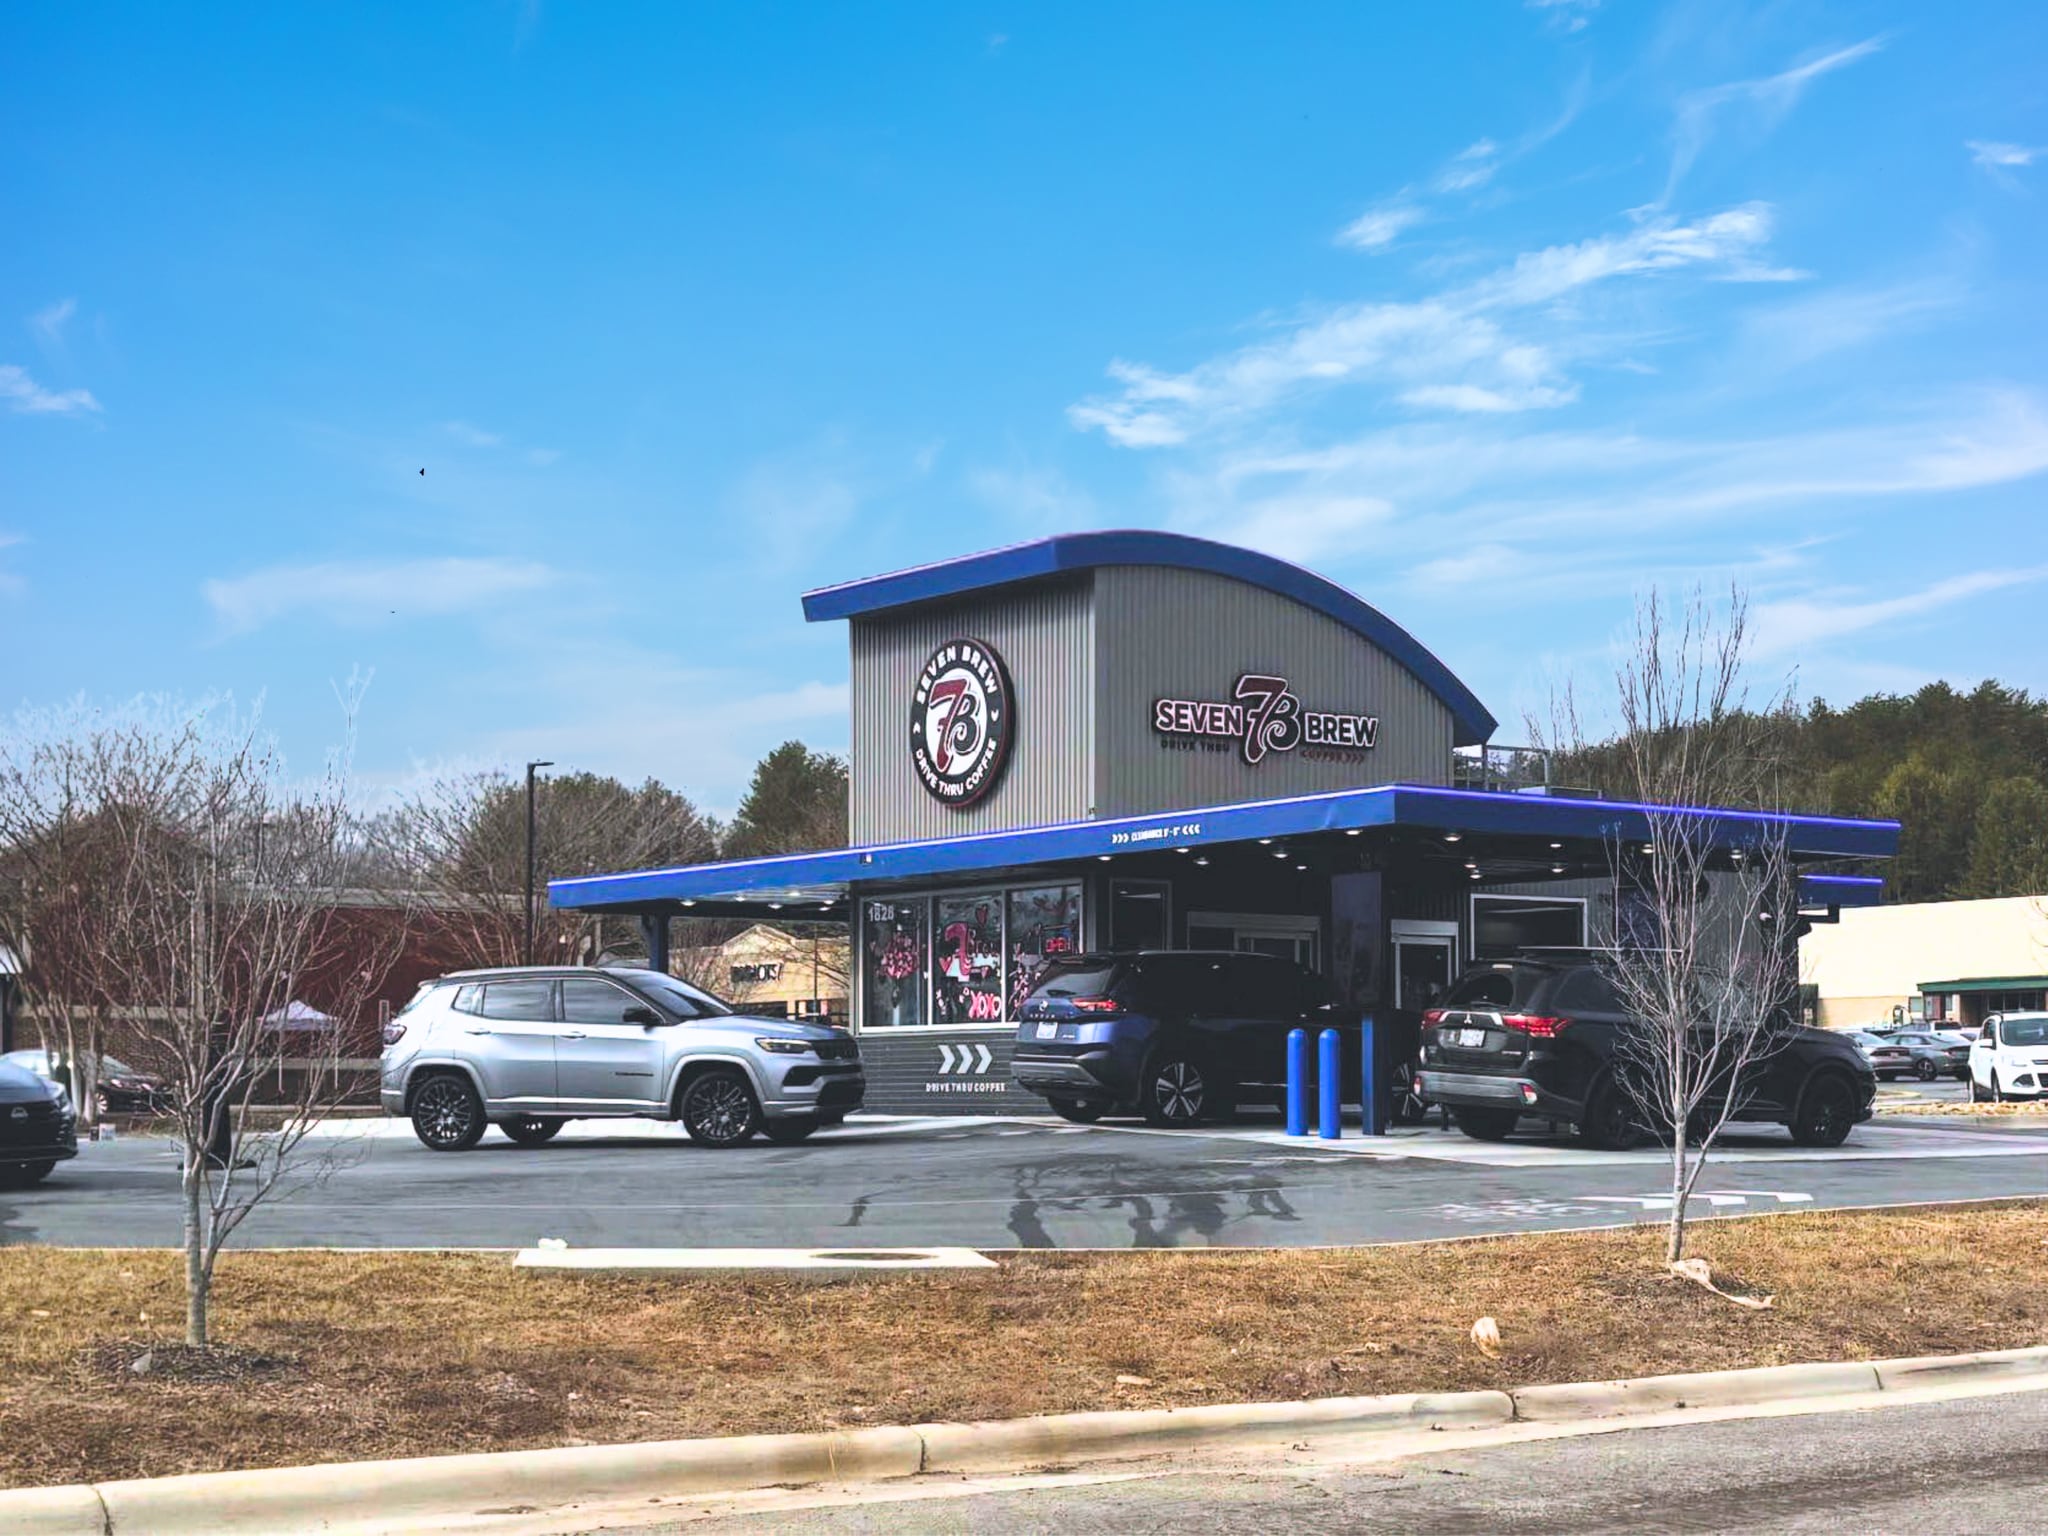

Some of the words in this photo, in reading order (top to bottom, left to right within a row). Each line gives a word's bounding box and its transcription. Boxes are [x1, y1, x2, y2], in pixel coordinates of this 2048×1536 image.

[916, 646, 957, 704] SEVEN
[961, 645, 998, 693] BREW
[1156, 699, 1243, 736] SEVEN
[1305, 712, 1378, 747] BREW
[915, 748, 938, 789] DRIVE
[938, 780, 964, 796] THRU
[965, 738, 997, 790] COFFEE
[969, 991, 1001, 1019] XOXO
[926, 1083, 949, 1092] DRIVE
[952, 1083, 973, 1092] THRU
[974, 1083, 1005, 1092] COFFEE
